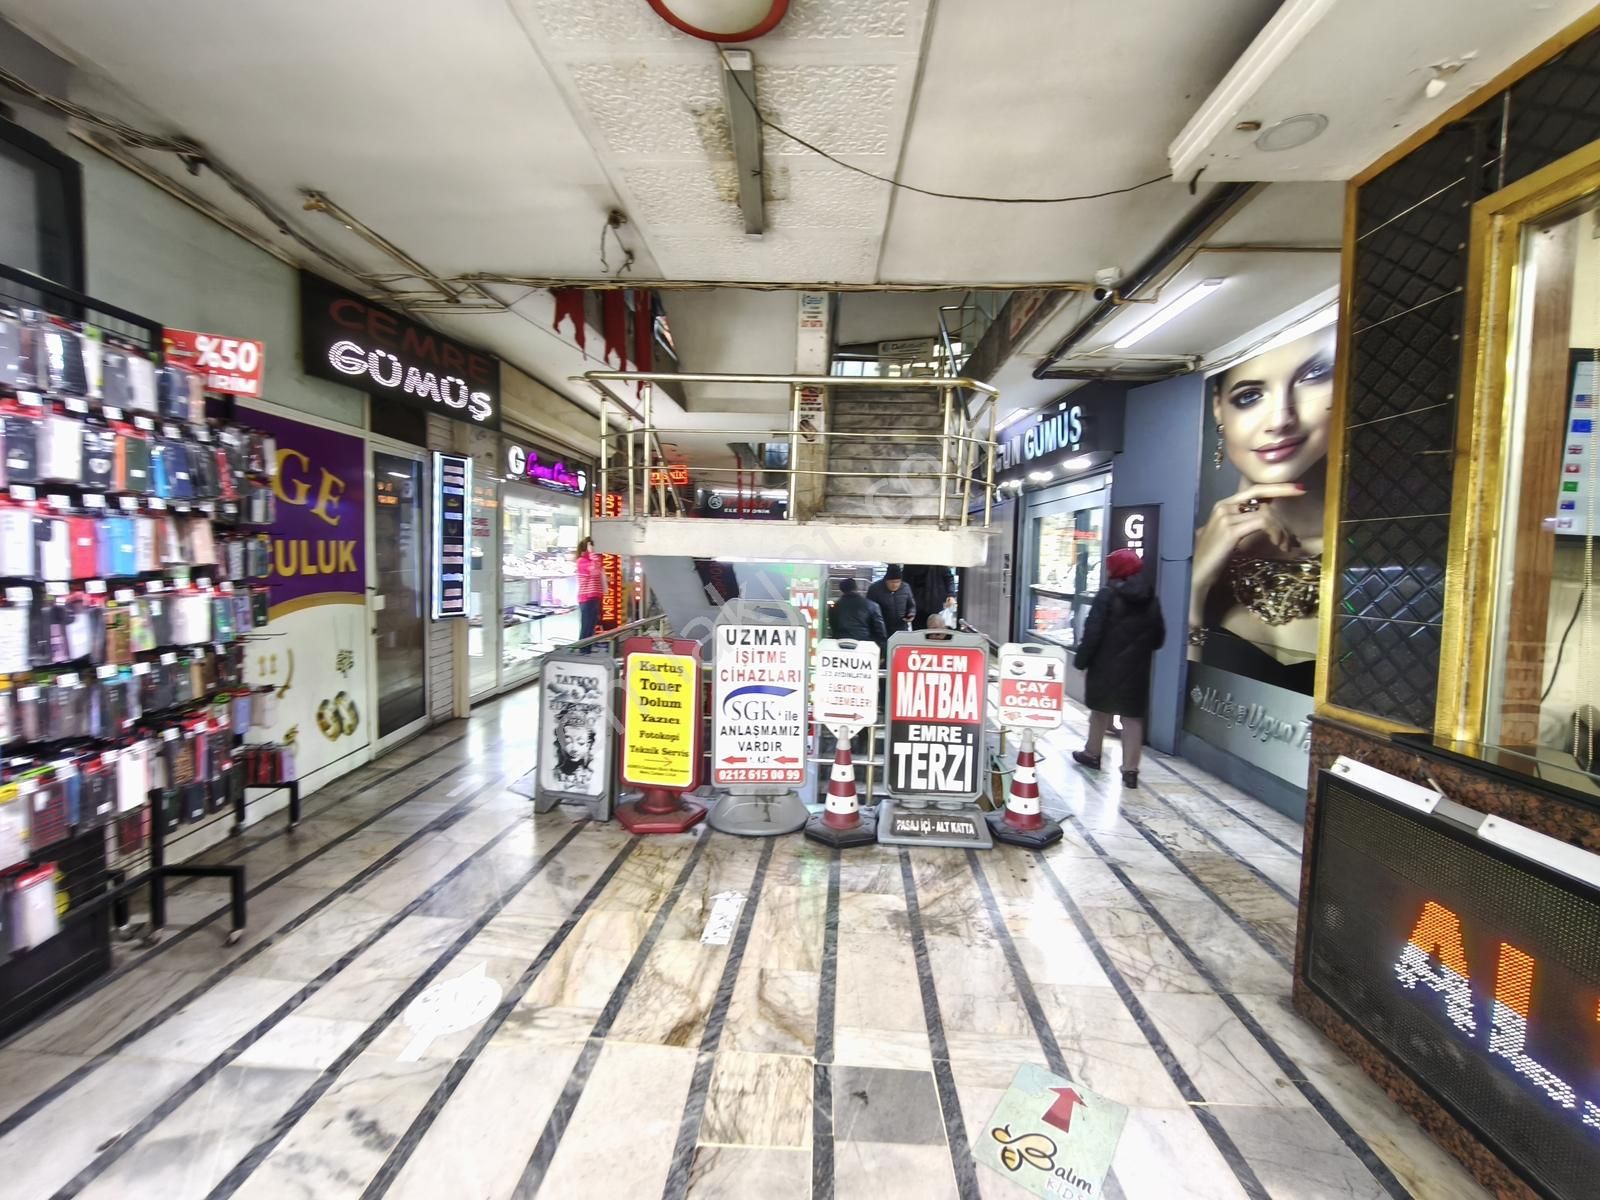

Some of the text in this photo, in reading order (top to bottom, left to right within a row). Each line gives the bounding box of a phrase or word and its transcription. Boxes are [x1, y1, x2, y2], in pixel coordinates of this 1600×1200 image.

[329, 298, 491, 385] CEMRE
[195, 335, 257, 372] %50
[328, 340, 492, 421] GÜMÜŞ
[1024, 402, 1083, 461] GÜMÜŞ
[270, 448, 346, 527] GE
[256, 531, 358, 578] CULUK
[726, 629, 796, 646] UZMAN
[736, 648, 786, 666] İŞİTME
[822, 656, 872, 670] DENUM
[908, 651, 968, 672] ÖZLEM
[639, 660, 684, 677] Kartuş
[721, 666, 801, 682] CİHAZLARI
[640, 679, 682, 692] Toner
[1016, 682, 1048, 695] ÇAY
[640, 696, 682, 709] Dolum
[896, 672, 978, 721] MATBAA
[1005, 695, 1057, 709] OCAĞI
[640, 714, 680, 725] Yazıcı
[731, 701, 798, 721] SGK ile
[639, 731, 680, 743] Fotokopi
[720, 725, 800, 738] ANLAŞMAMIZ
[908, 725, 962, 744] EMRE
[629, 745, 689, 758] Teknik Servis
[738, 741, 782, 751] VARDIR
[893, 733, 974, 792] TERZİ
[897, 820, 919, 831] PASAJ
[936, 821, 950, 832] ALT
[951, 822, 975, 834] KATTA
